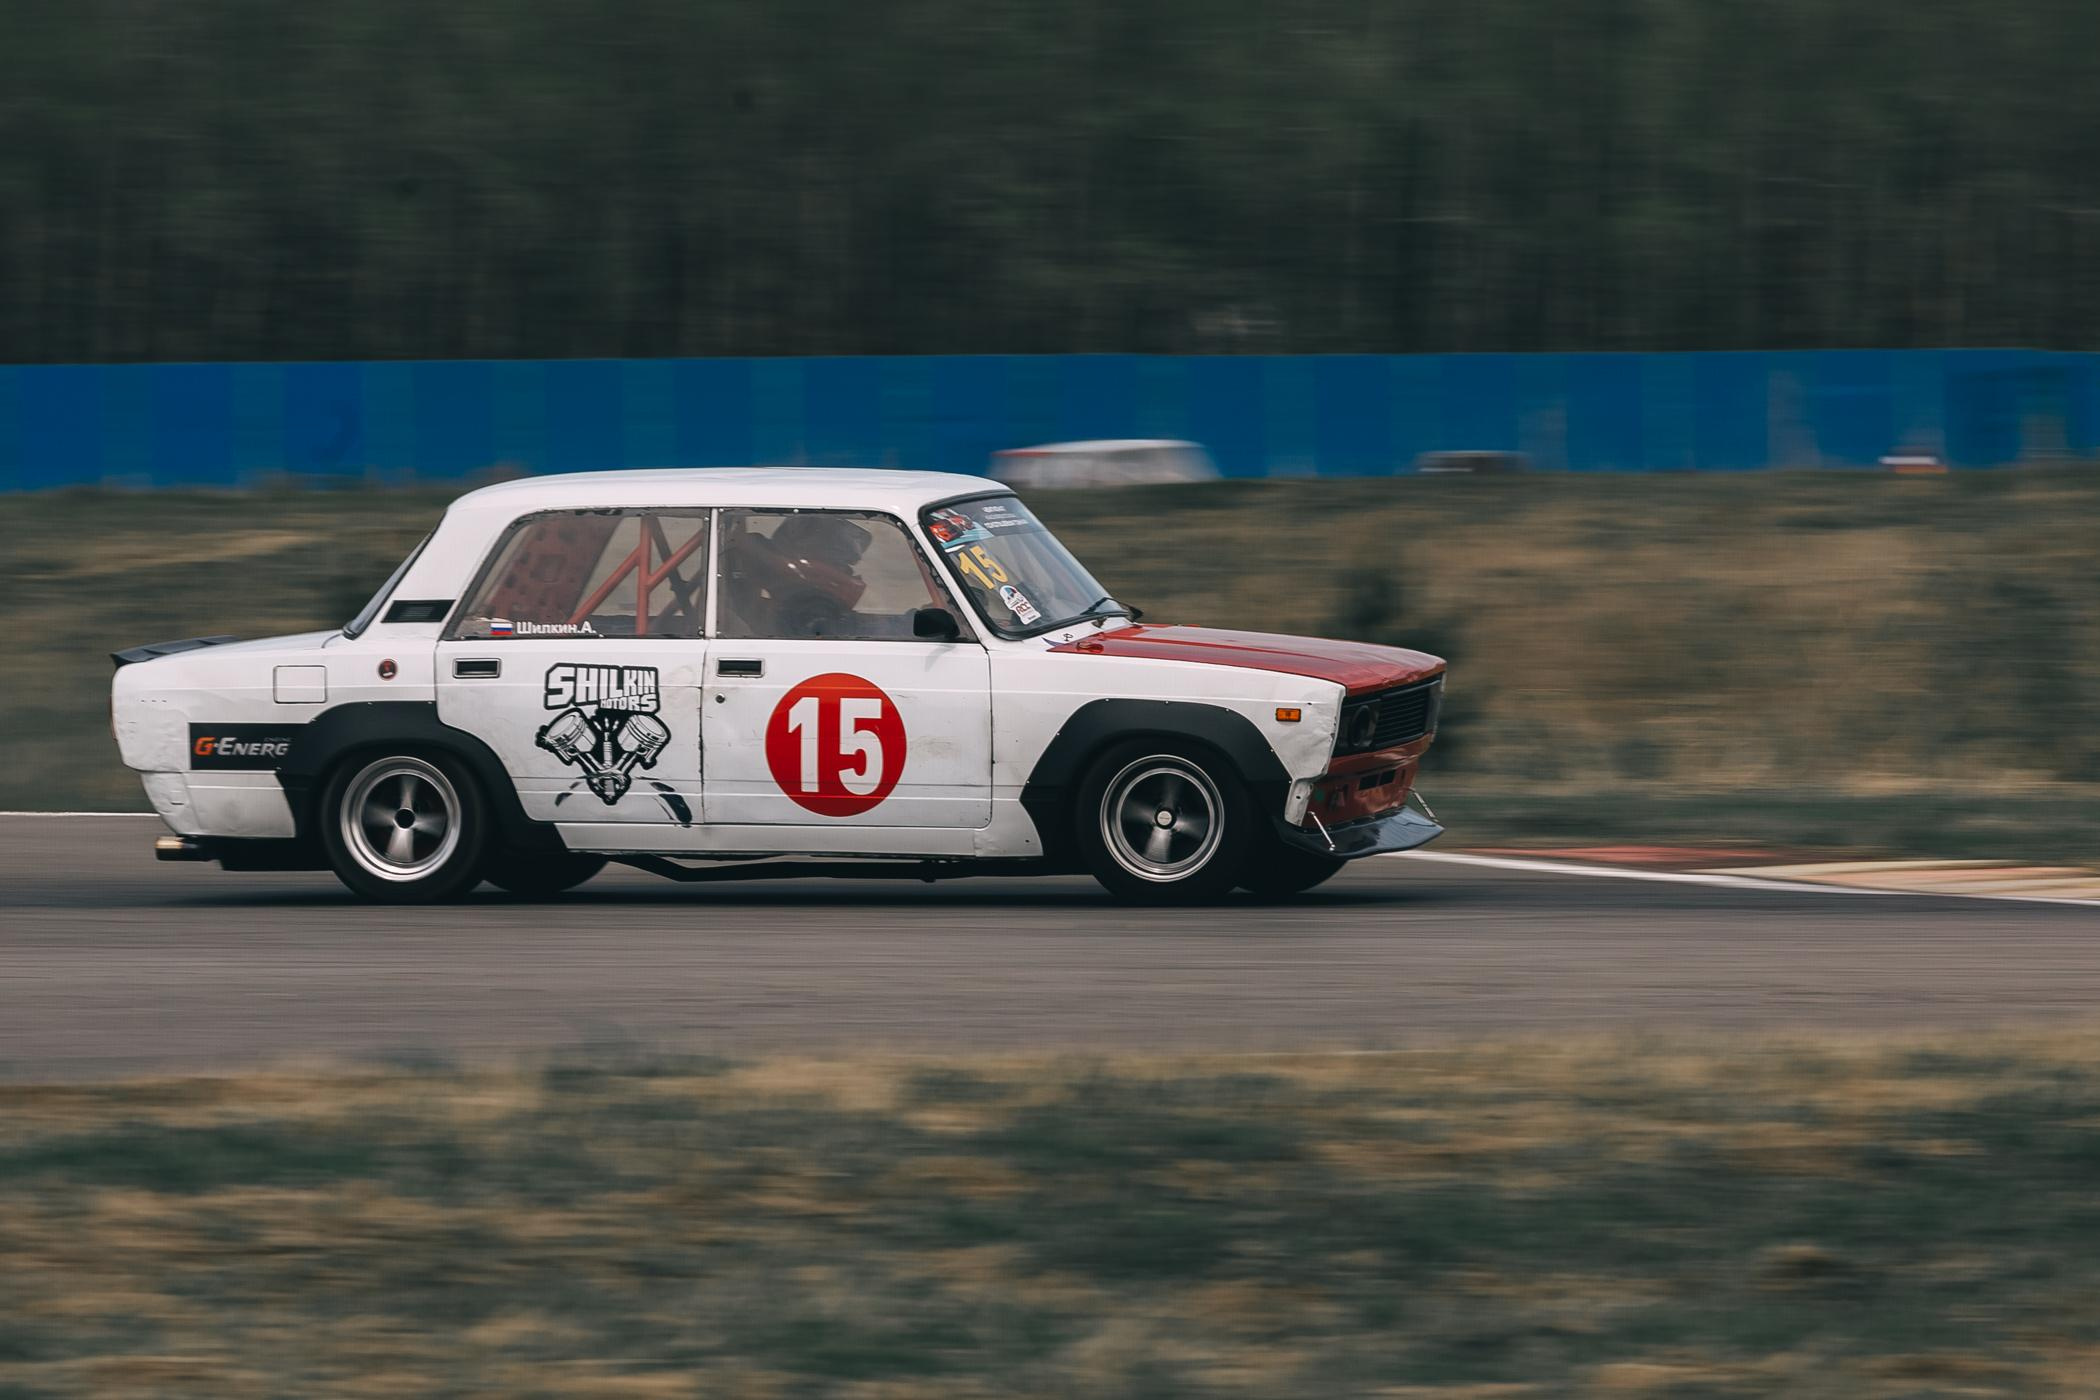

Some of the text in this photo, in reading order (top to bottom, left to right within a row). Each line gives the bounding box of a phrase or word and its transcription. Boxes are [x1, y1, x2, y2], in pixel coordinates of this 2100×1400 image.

[959, 546, 1008, 589] 15
[547, 666, 656, 706] SHILKIN
[600, 693, 657, 712] MOTORS
[788, 697, 883, 795] 15
